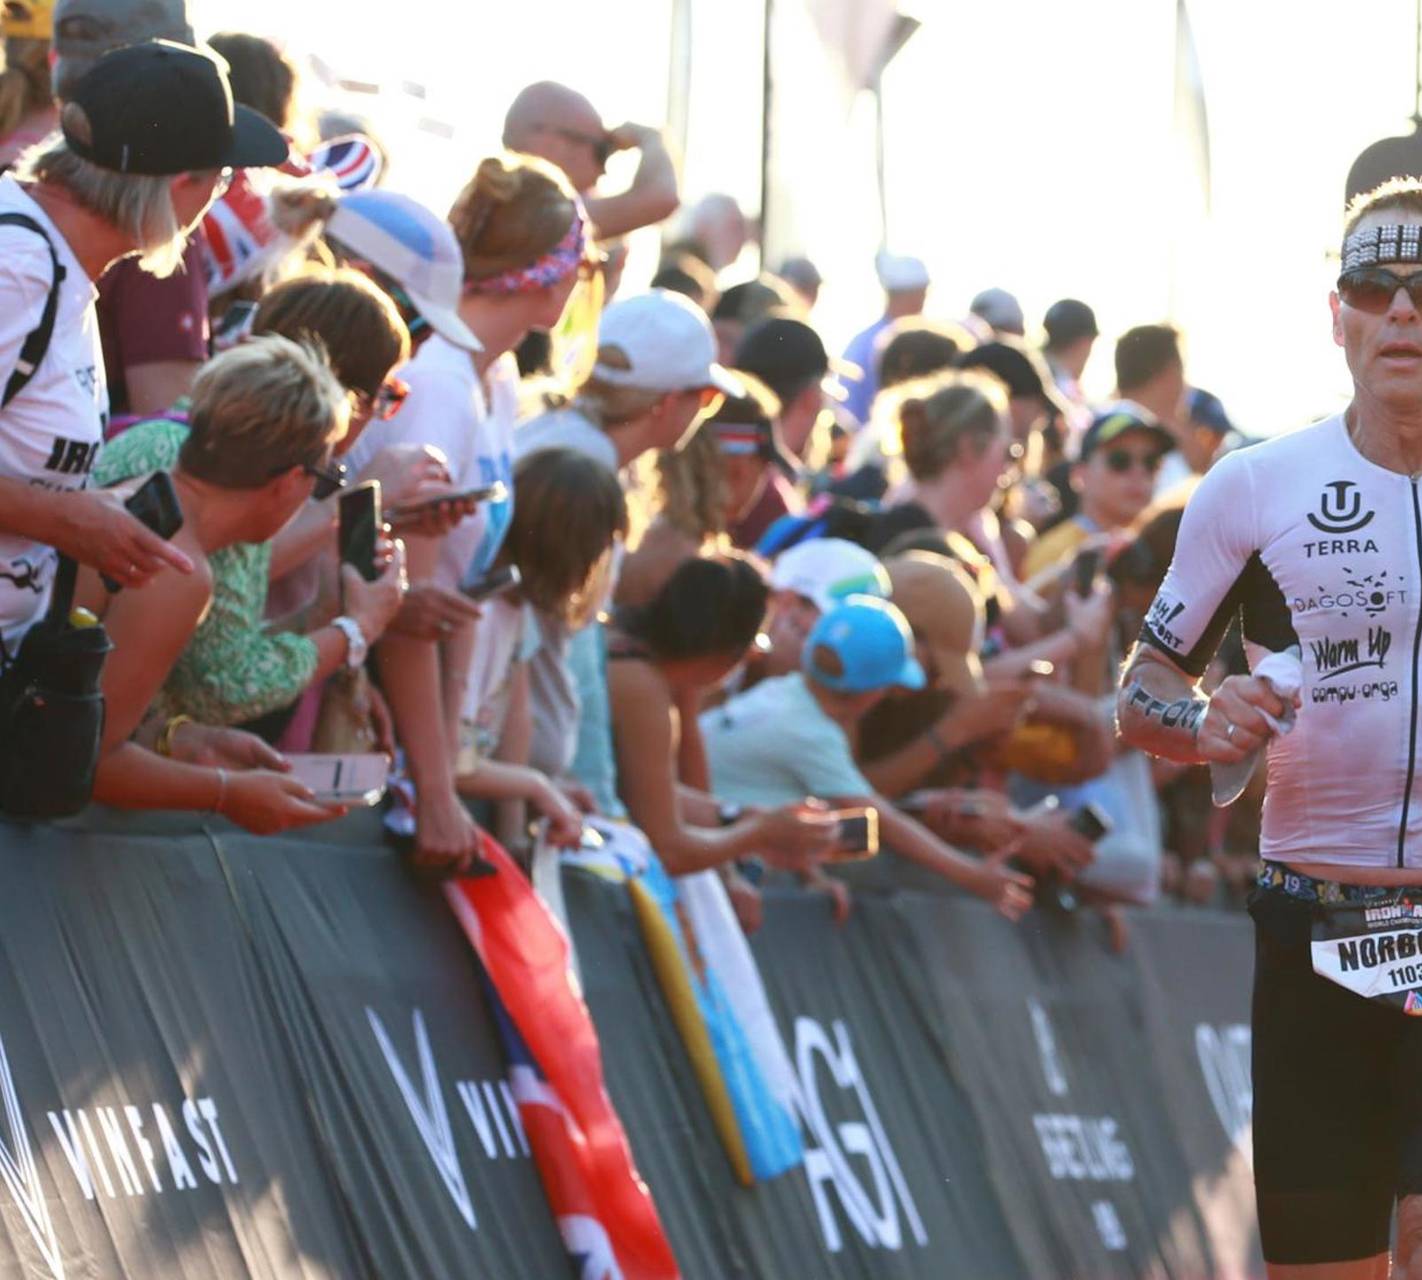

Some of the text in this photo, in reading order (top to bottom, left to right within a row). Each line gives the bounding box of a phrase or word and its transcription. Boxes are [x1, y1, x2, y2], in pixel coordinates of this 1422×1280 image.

[1303, 540, 1379, 558] TERRA
[1310, 626, 1391, 671] Warm Up
[47, 1096, 239, 1200] VINFAST
